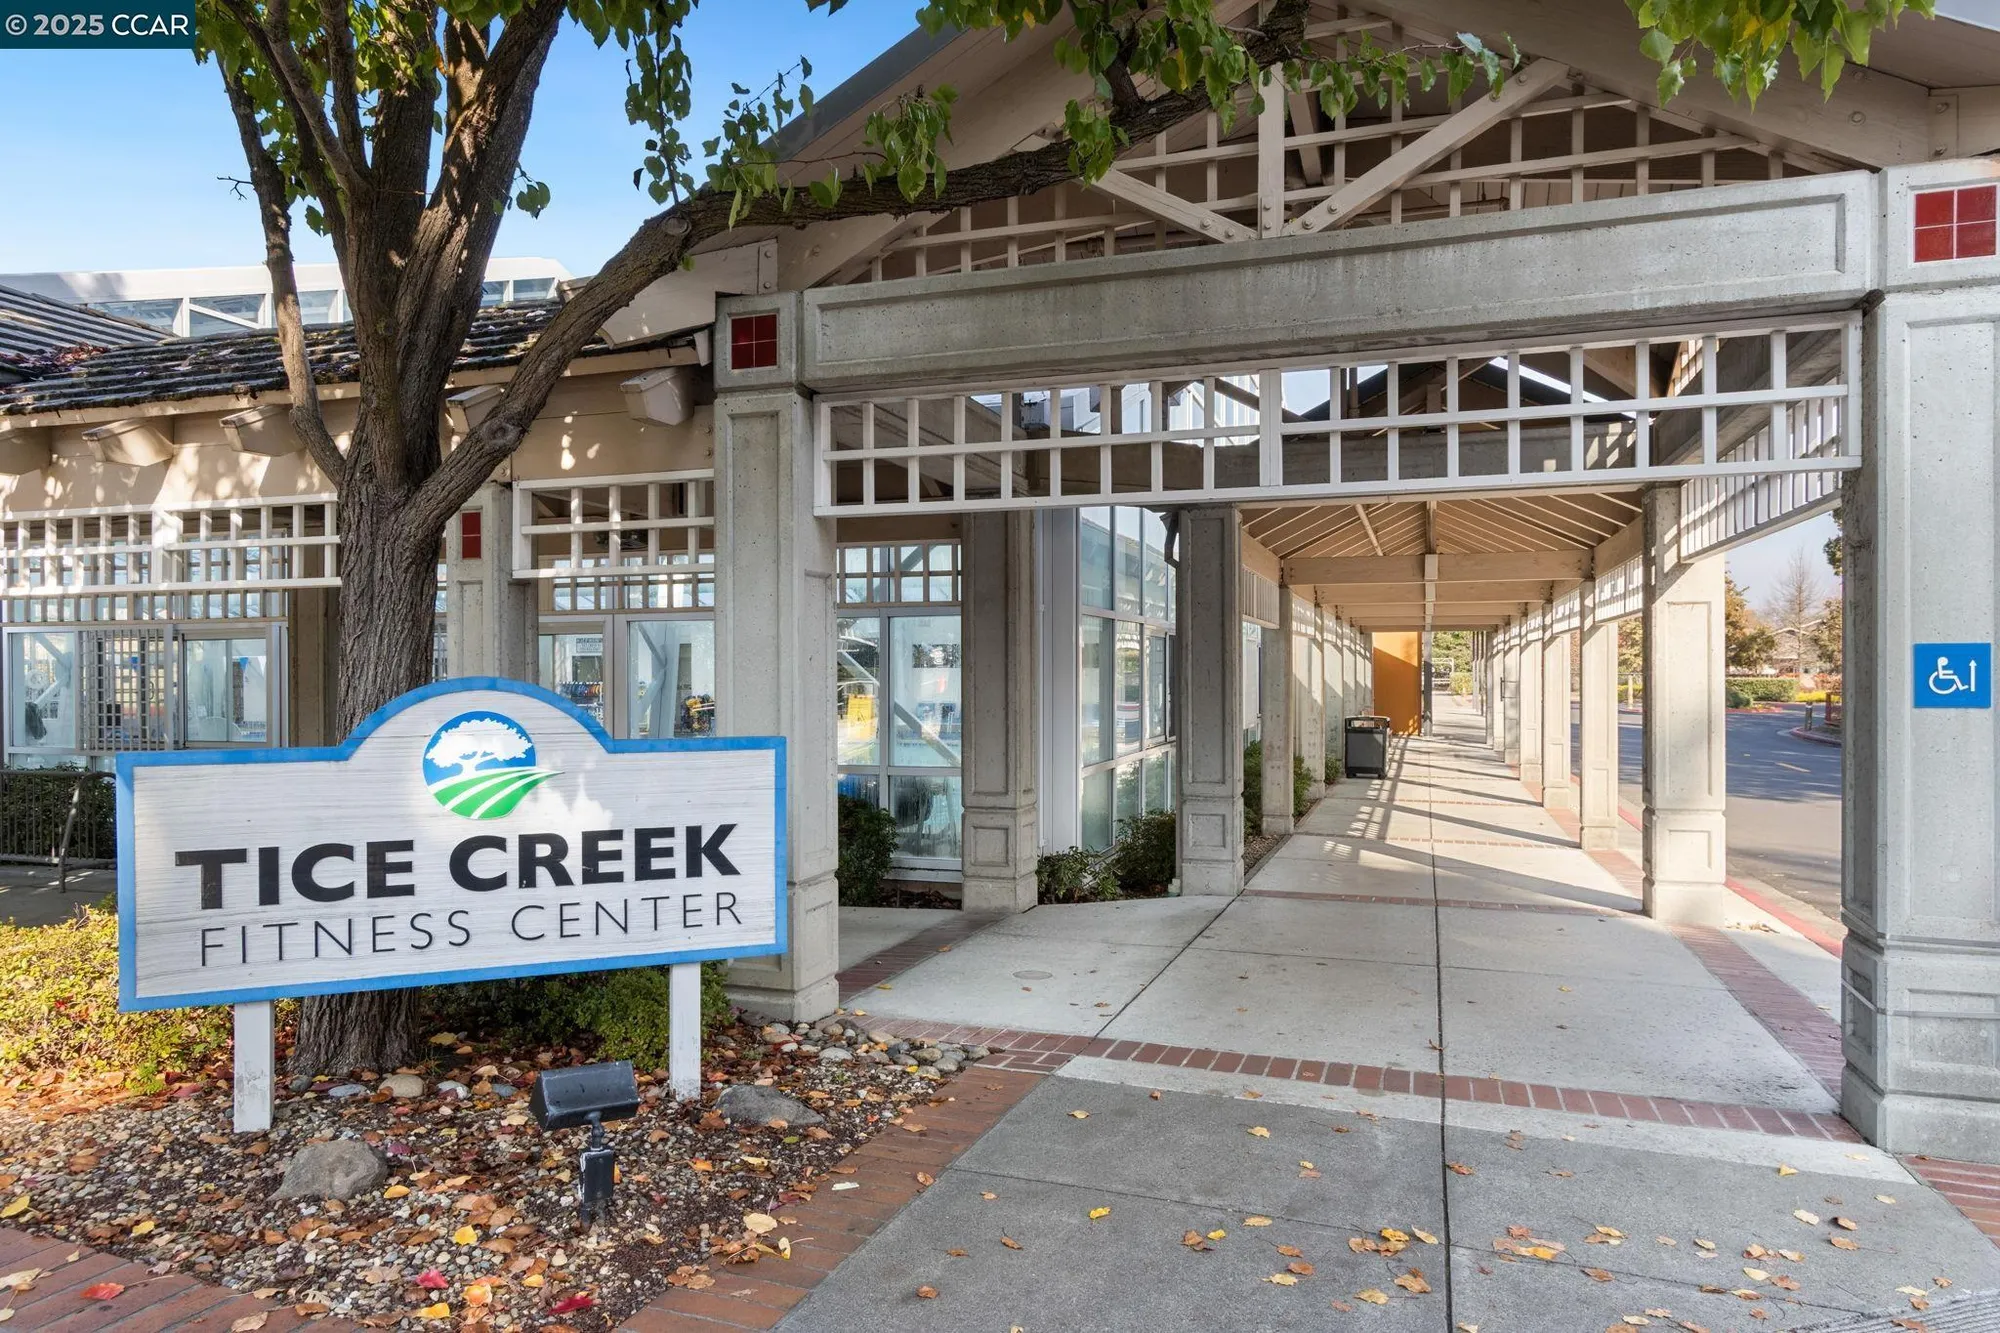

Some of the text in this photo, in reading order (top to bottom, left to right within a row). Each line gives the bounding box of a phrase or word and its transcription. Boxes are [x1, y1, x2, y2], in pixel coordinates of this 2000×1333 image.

[175, 823, 740, 910] TICE CREEK
[201, 891, 741, 966] FITNESS CENTER
